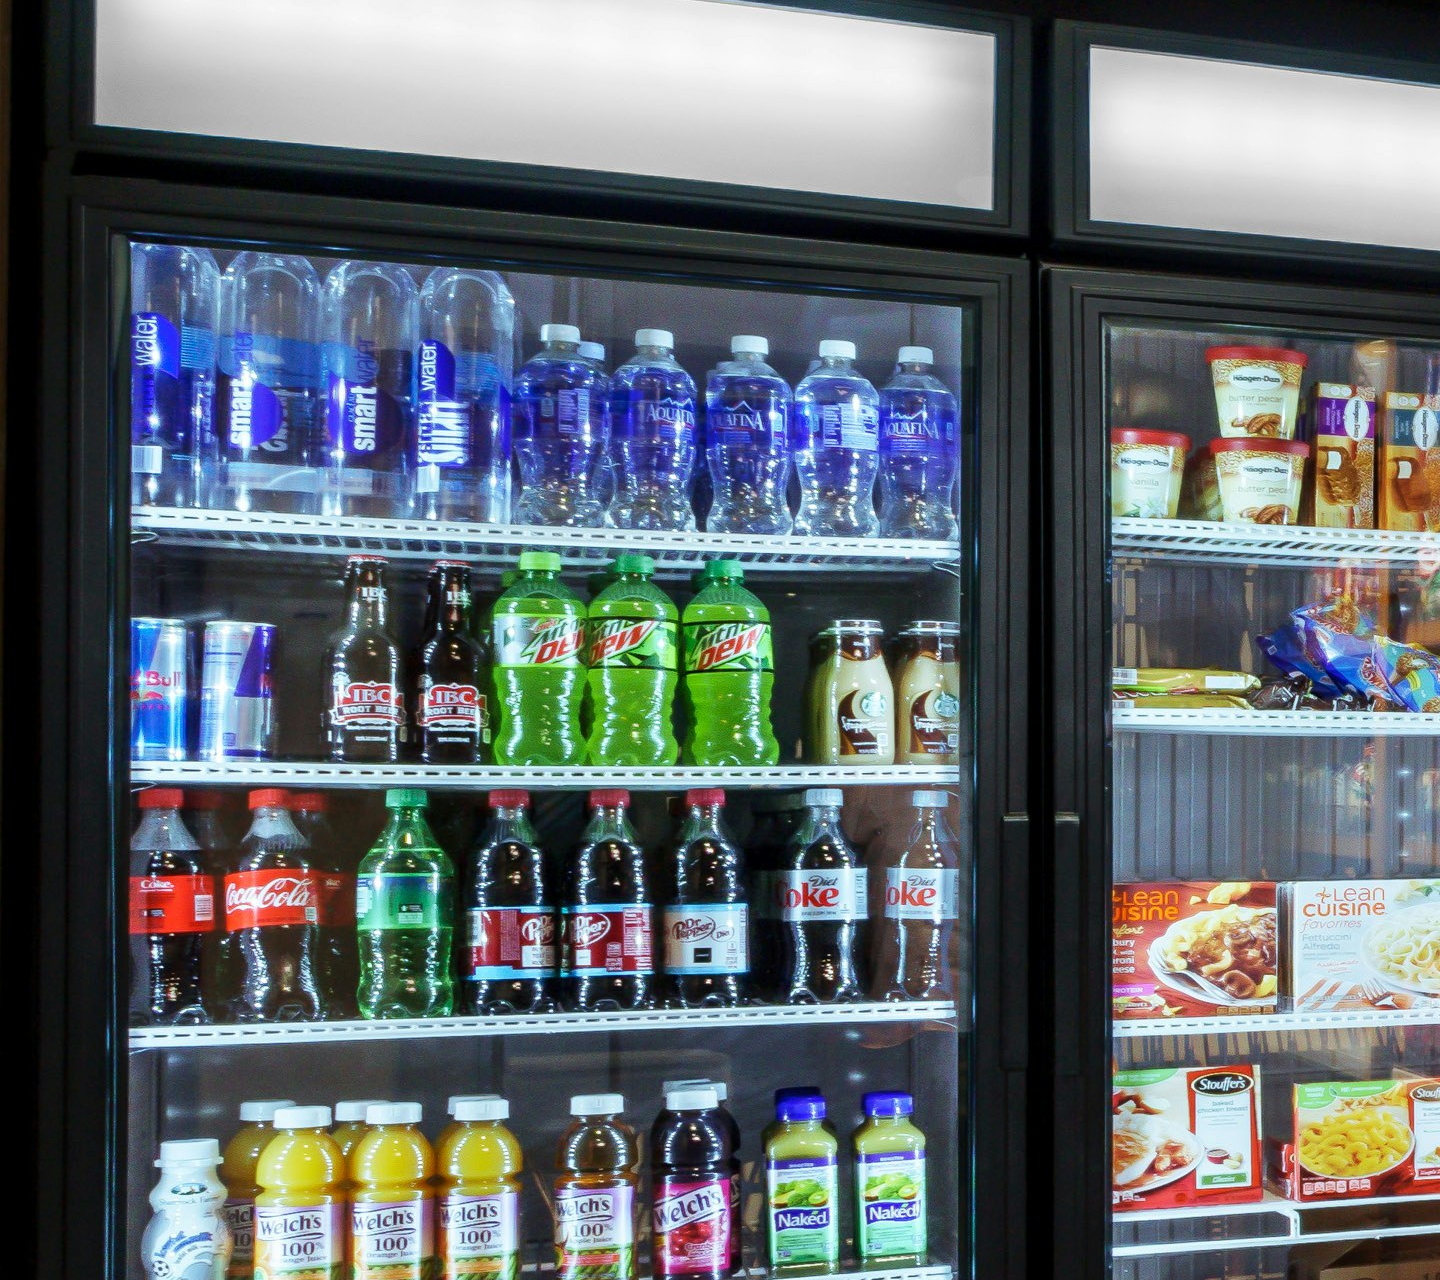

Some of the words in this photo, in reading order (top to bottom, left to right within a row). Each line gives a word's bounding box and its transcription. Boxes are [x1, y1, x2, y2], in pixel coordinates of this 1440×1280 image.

[419, 341, 438, 394] water
[1229, 394, 1254, 403] butter
[1258, 394, 1283, 404] pecan
[353, 385, 377, 452] smart
[884, 421, 939, 441] AQUAFINA
[145, 670, 182, 687] Bull
[353, 689, 390, 703] IBC
[435, 690, 475, 704] IBC
[811, 875, 838, 887] Diet
[225, 878, 313, 913] Coca-Cola
[1196, 1073, 1251, 1093] Stouffer's
[654, 1188, 723, 1227] Welch's
[260, 1213, 322, 1238] Welch's
[353, 1209, 415, 1232] Welch's
[778, 1209, 829, 1229] Naked
[459, 1229, 501, 1245] 100%
